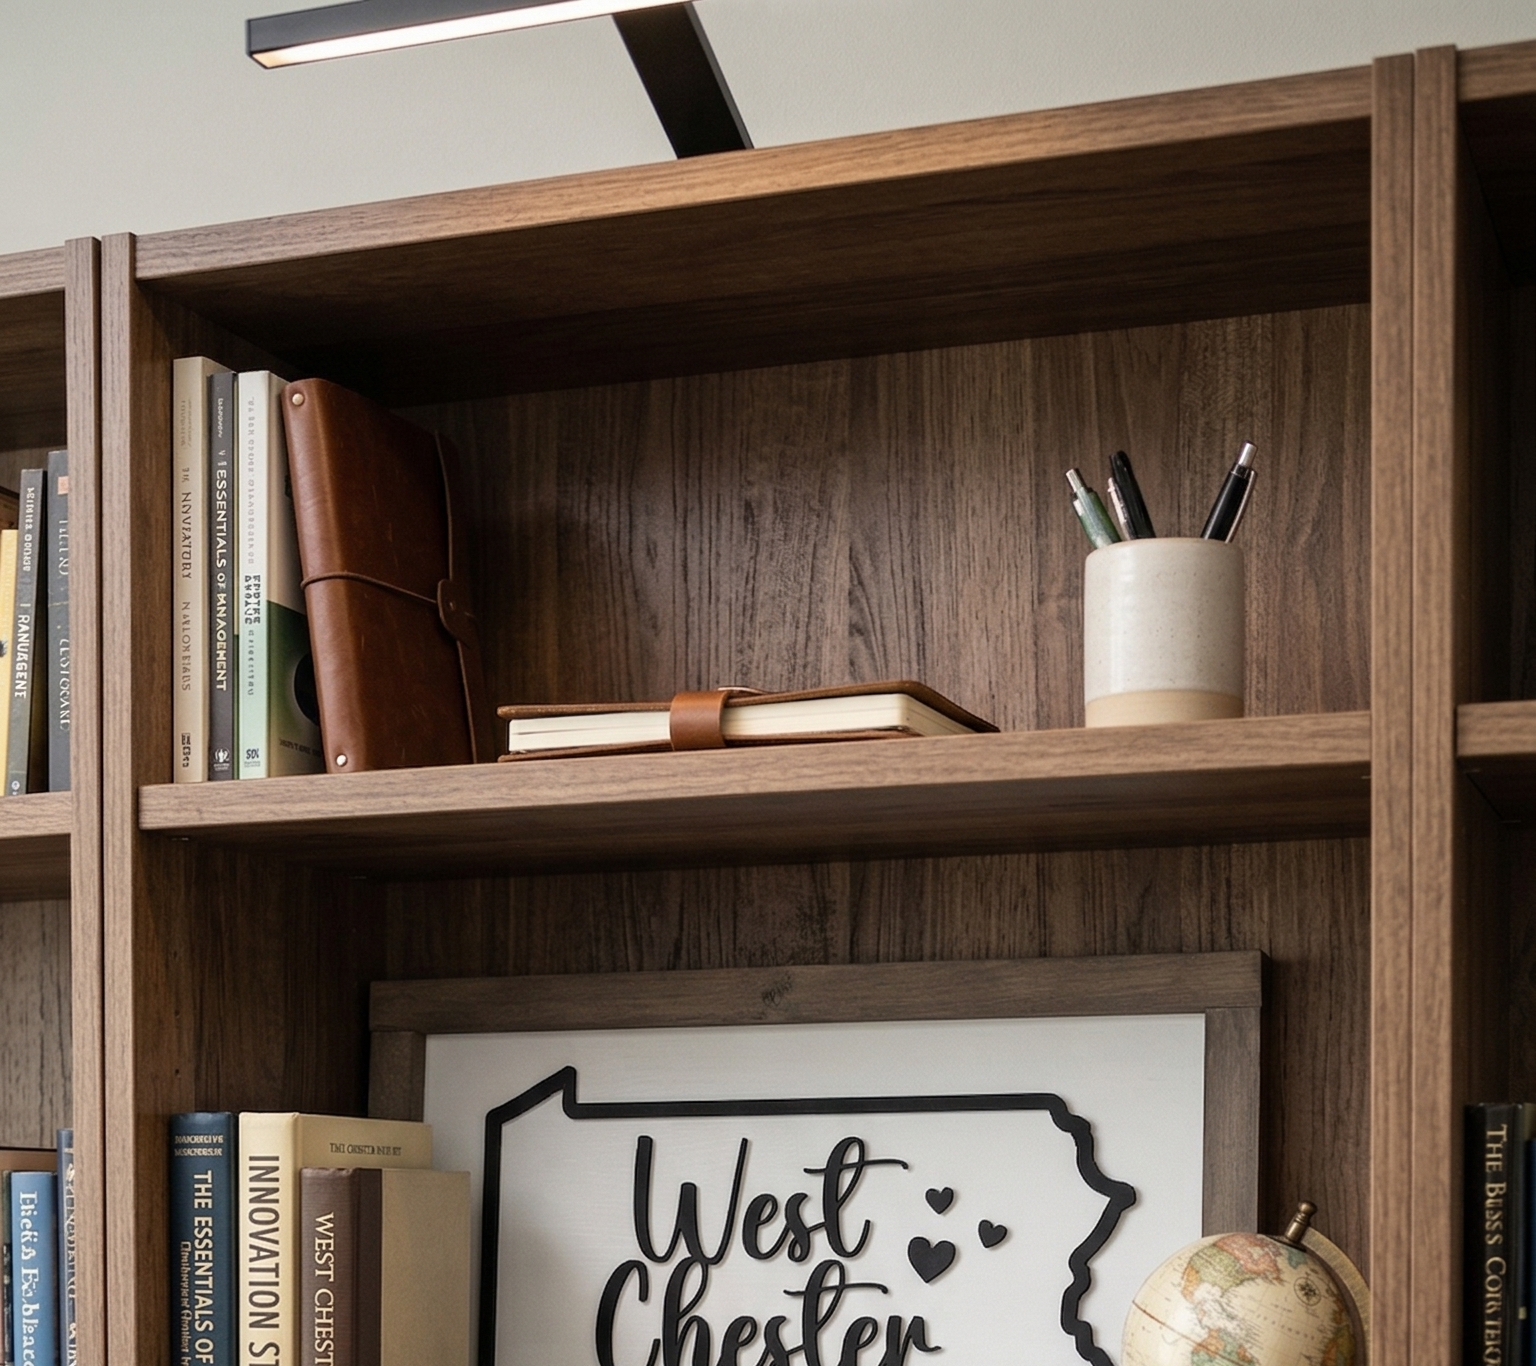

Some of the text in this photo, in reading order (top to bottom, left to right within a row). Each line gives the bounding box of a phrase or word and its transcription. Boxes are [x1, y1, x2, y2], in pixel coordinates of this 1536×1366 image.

[215, 469, 227, 569] ESSENTIALS
[194, 1170, 212, 1209] THE
[633, 1135, 909, 1265] West
[194, 1216, 214, 1332] ESSENTIALS
[248, 1155, 279, 1330] INNOVATION
[314, 1212, 335, 1281] WEST
[195, 1338, 213, 1364] OF
